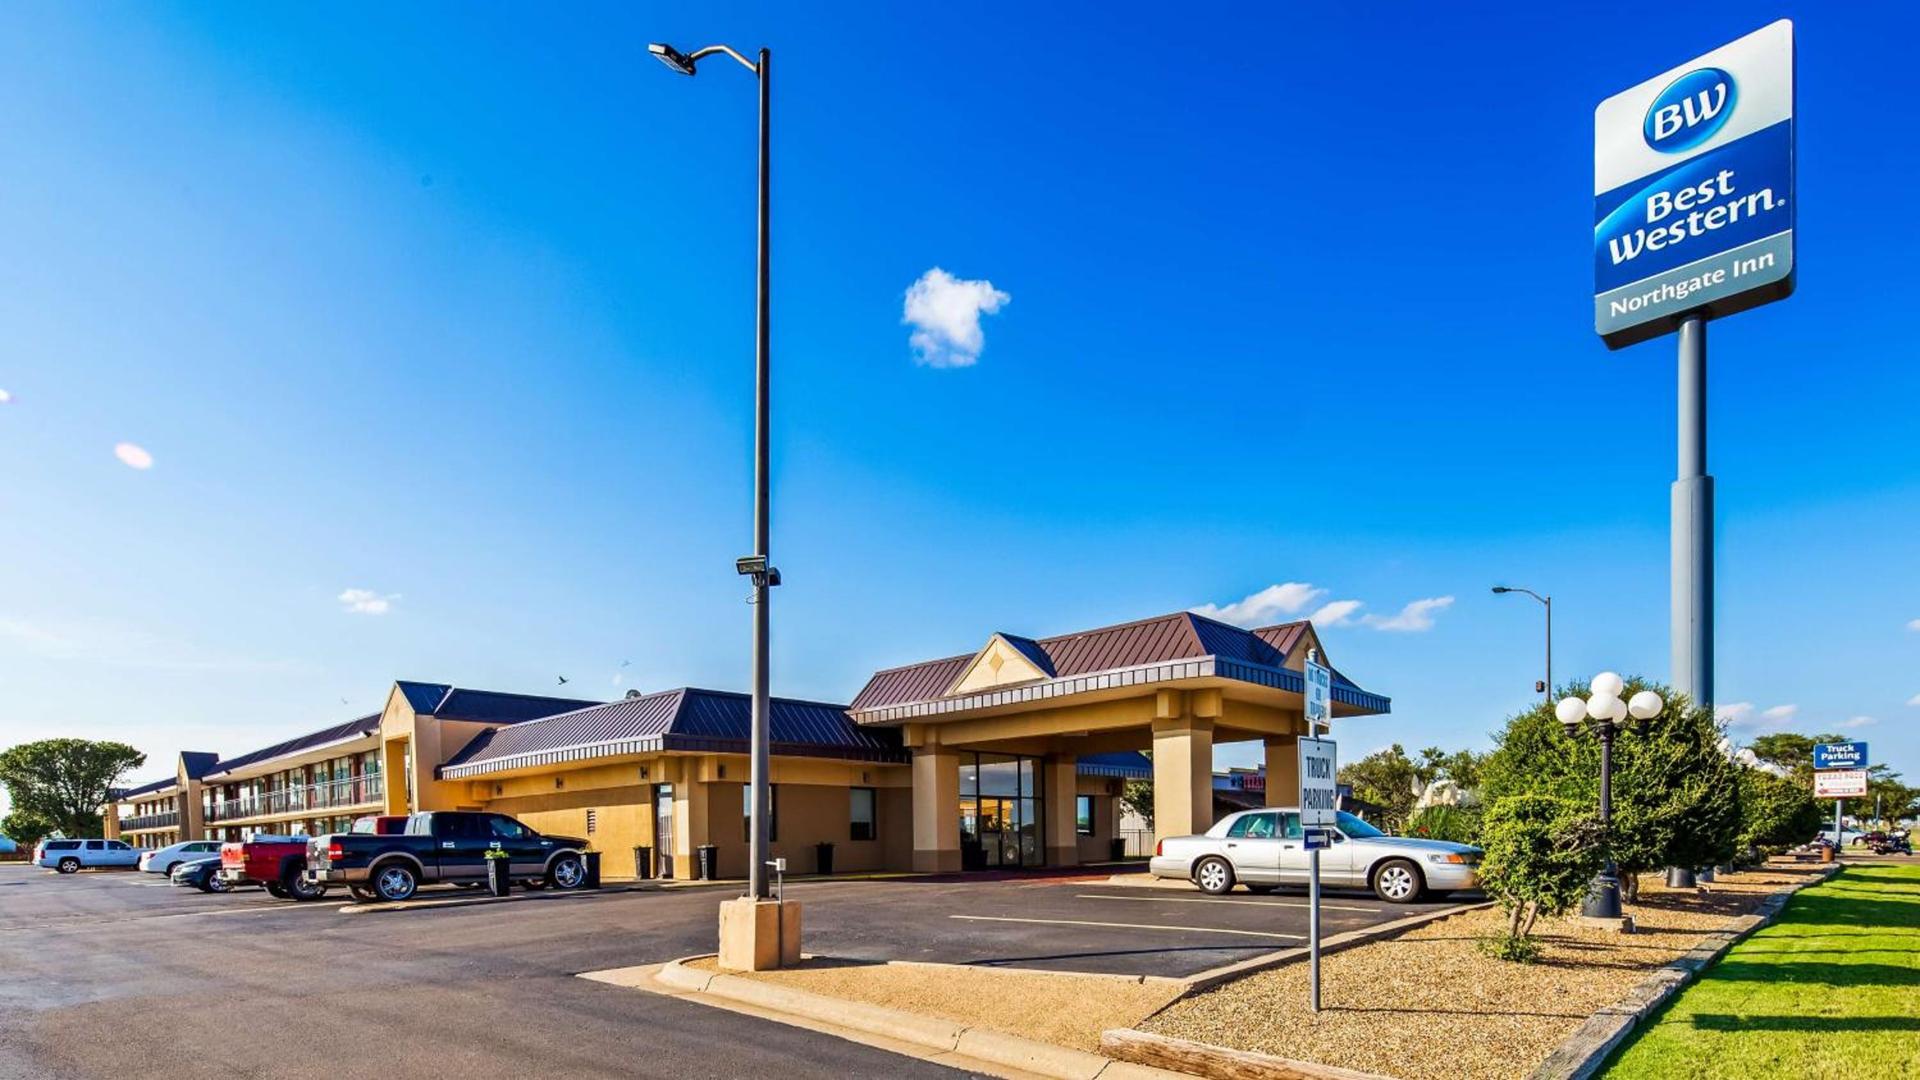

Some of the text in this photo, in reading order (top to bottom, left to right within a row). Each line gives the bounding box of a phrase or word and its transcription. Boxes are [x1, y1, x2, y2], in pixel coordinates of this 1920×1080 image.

[1654, 82, 1727, 142] BW
[1646, 168, 1735, 224] Best
[1610, 252, 1775, 317] Northgate Inn
[1821, 752, 1861, 761] Parking
[1826, 744, 1855, 753] Truck
[1306, 756, 1331, 780] TRUCK
[1303, 788, 1335, 810] PARKING
